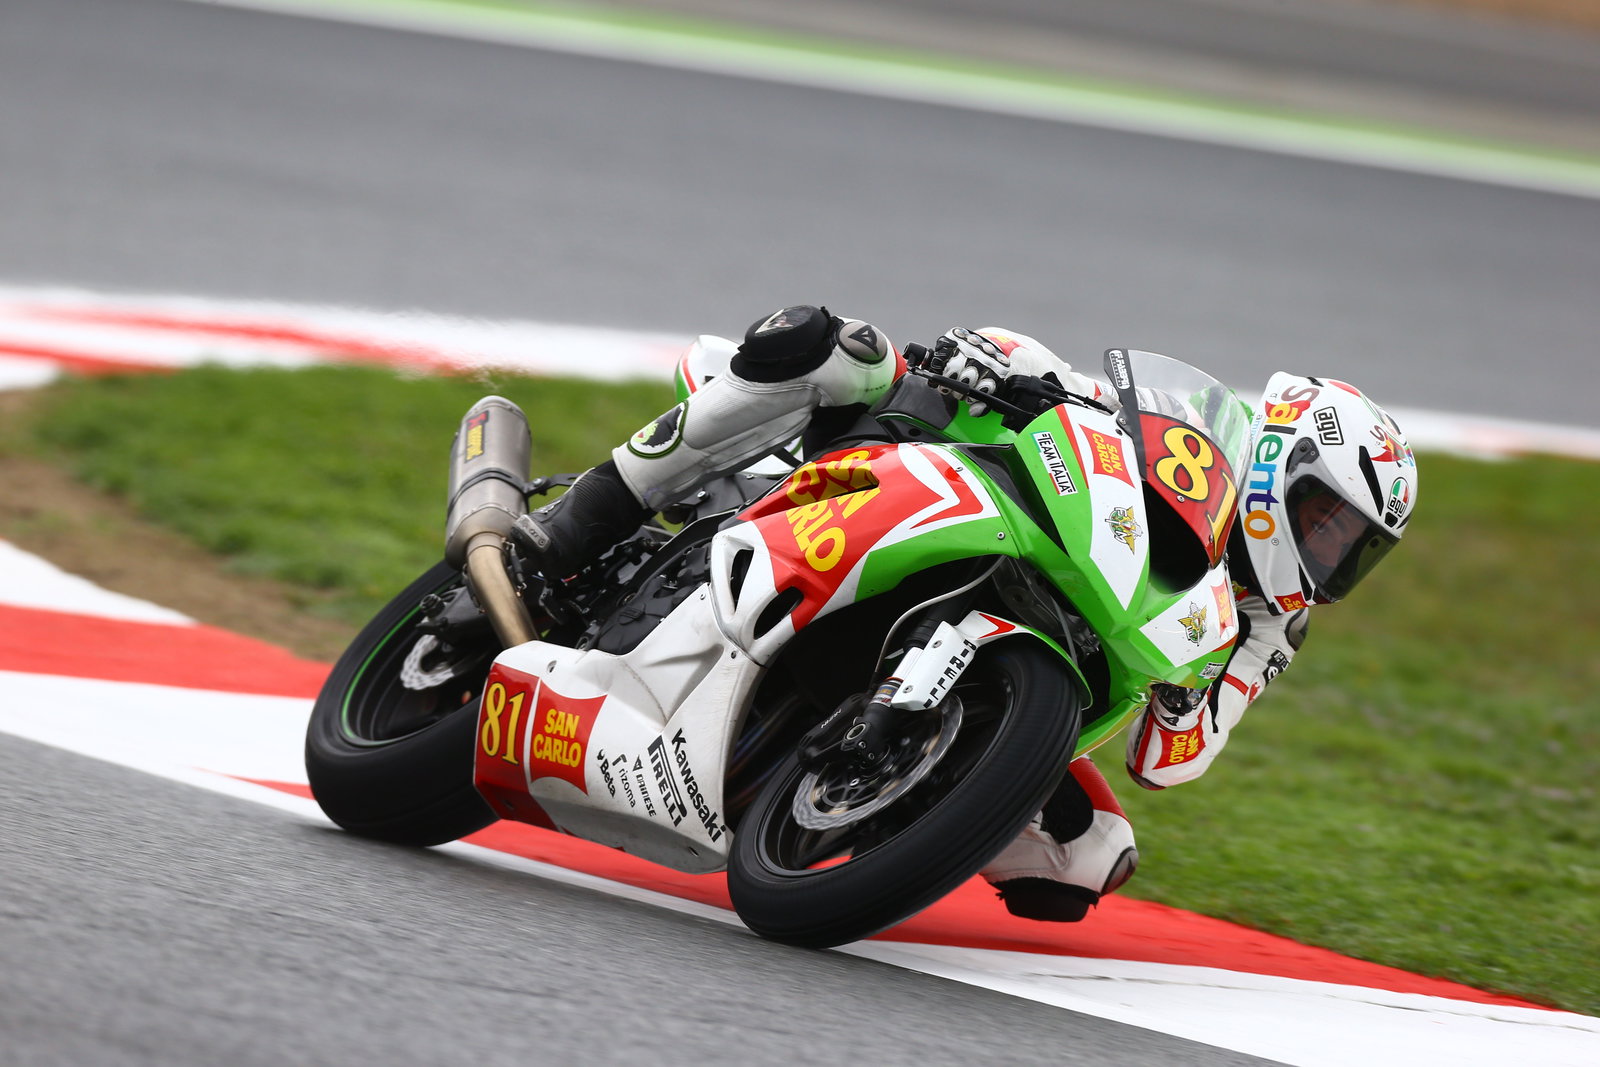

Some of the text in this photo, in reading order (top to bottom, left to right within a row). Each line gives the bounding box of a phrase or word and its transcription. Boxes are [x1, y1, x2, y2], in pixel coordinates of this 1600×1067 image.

[1314, 408, 1342, 444] agv
[1092, 433, 1115, 474] CARLO
[1106, 443, 1124, 472] SAN
[1244, 386, 1320, 540] Salento
[1155, 425, 1237, 557] 81
[481, 682, 525, 766] 81
[544, 708, 580, 739] SAN
[533, 736, 582, 768] CARLO
[1169, 734, 1188, 763] CARLO
[600, 758, 616, 798] Beta
[618, 768, 636, 808] rizoma
[648, 734, 688, 828] PIRELLI
[671, 728, 725, 843] Kawasaki
